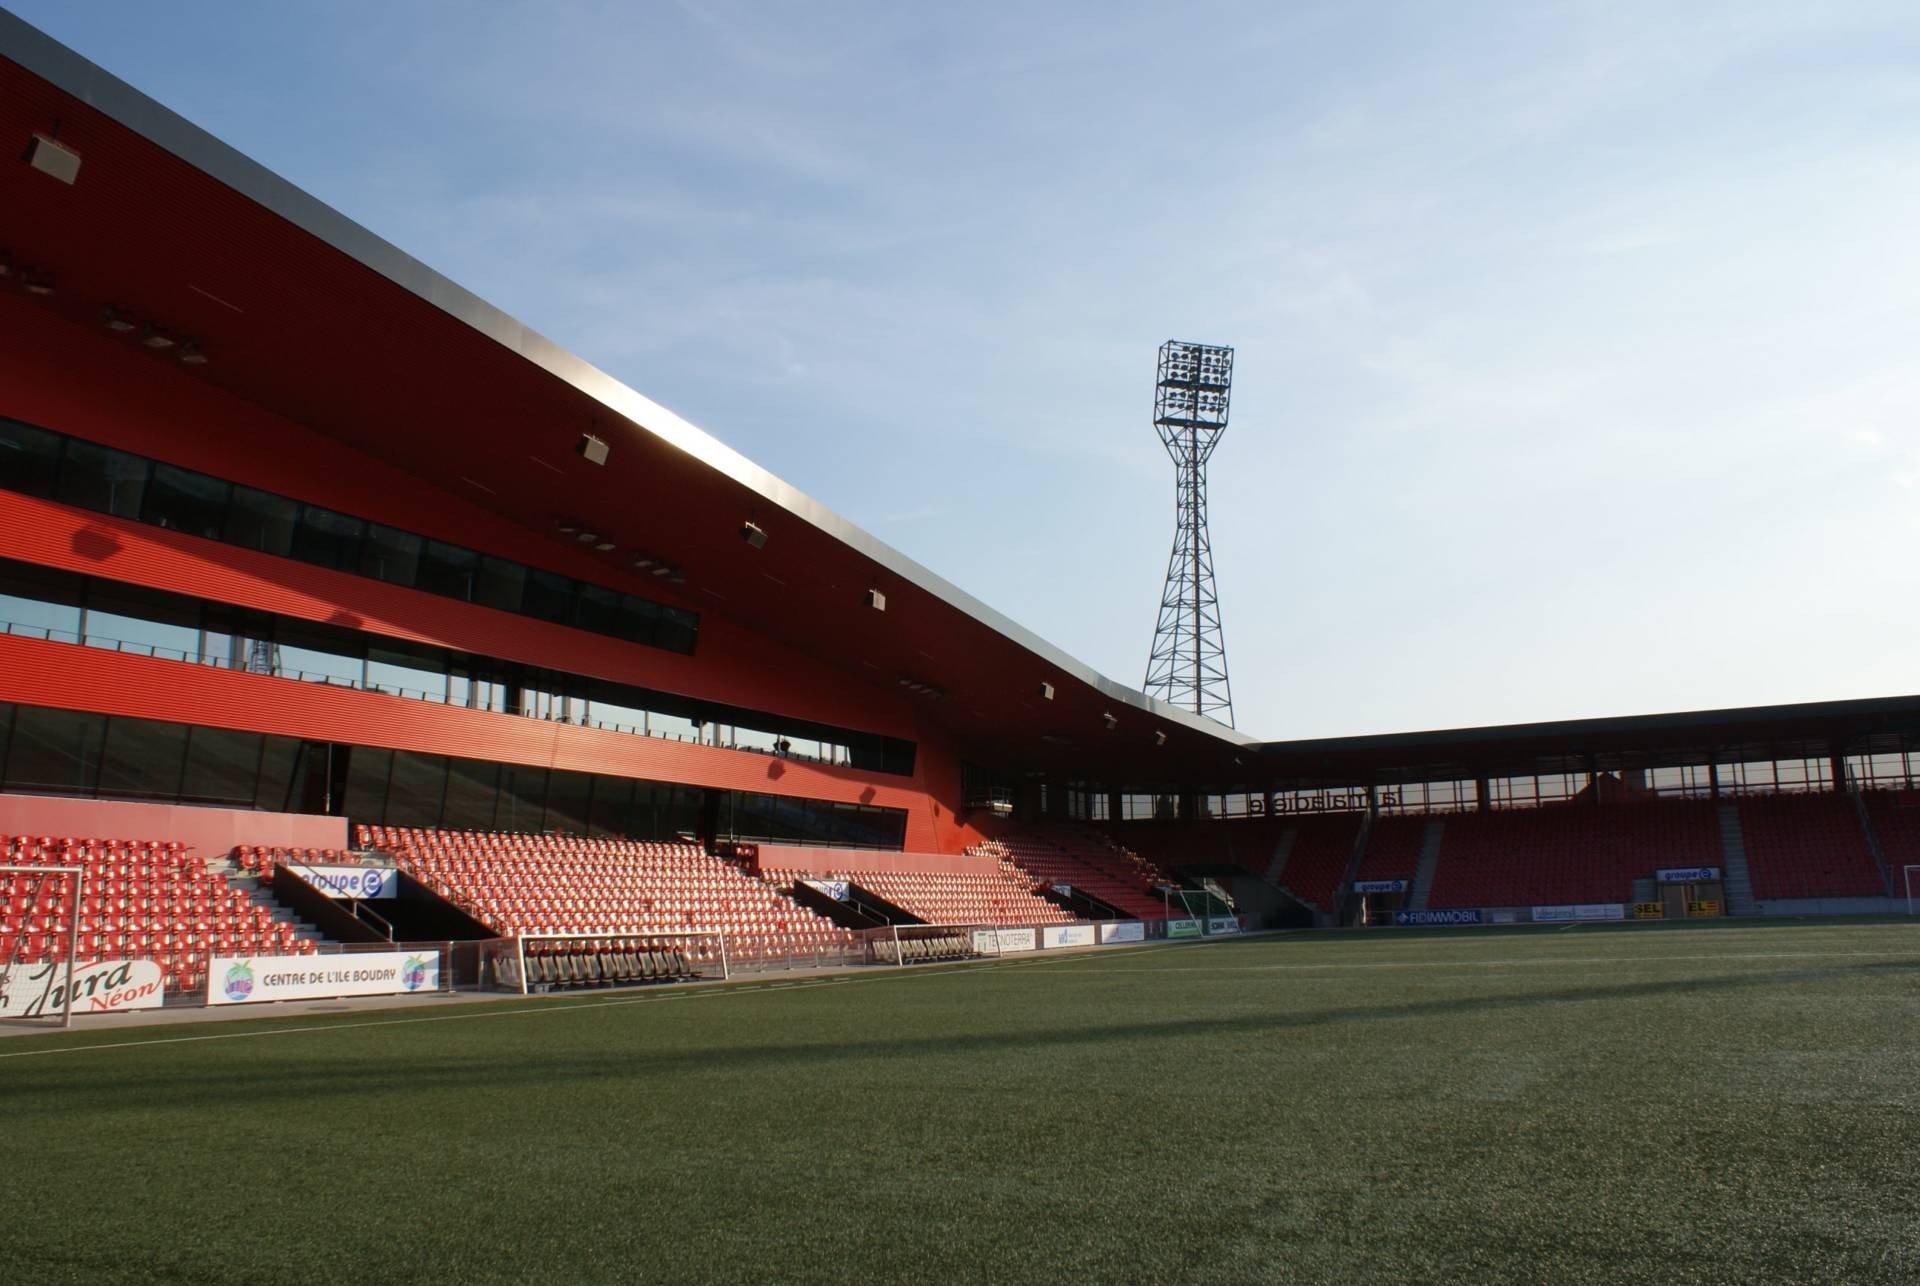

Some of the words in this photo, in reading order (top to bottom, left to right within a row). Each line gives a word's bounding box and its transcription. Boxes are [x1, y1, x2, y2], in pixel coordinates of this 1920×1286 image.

[1664, 871, 1697, 881] groupe
[1409, 910, 1479, 924] FIDIMMOBIL
[263, 971, 306, 987] CENTRE
[308, 970, 324, 984] DE
[353, 968, 397, 982] BOUDRY
[23, 962, 132, 1016] Jura
[90, 982, 155, 1011] Néon
